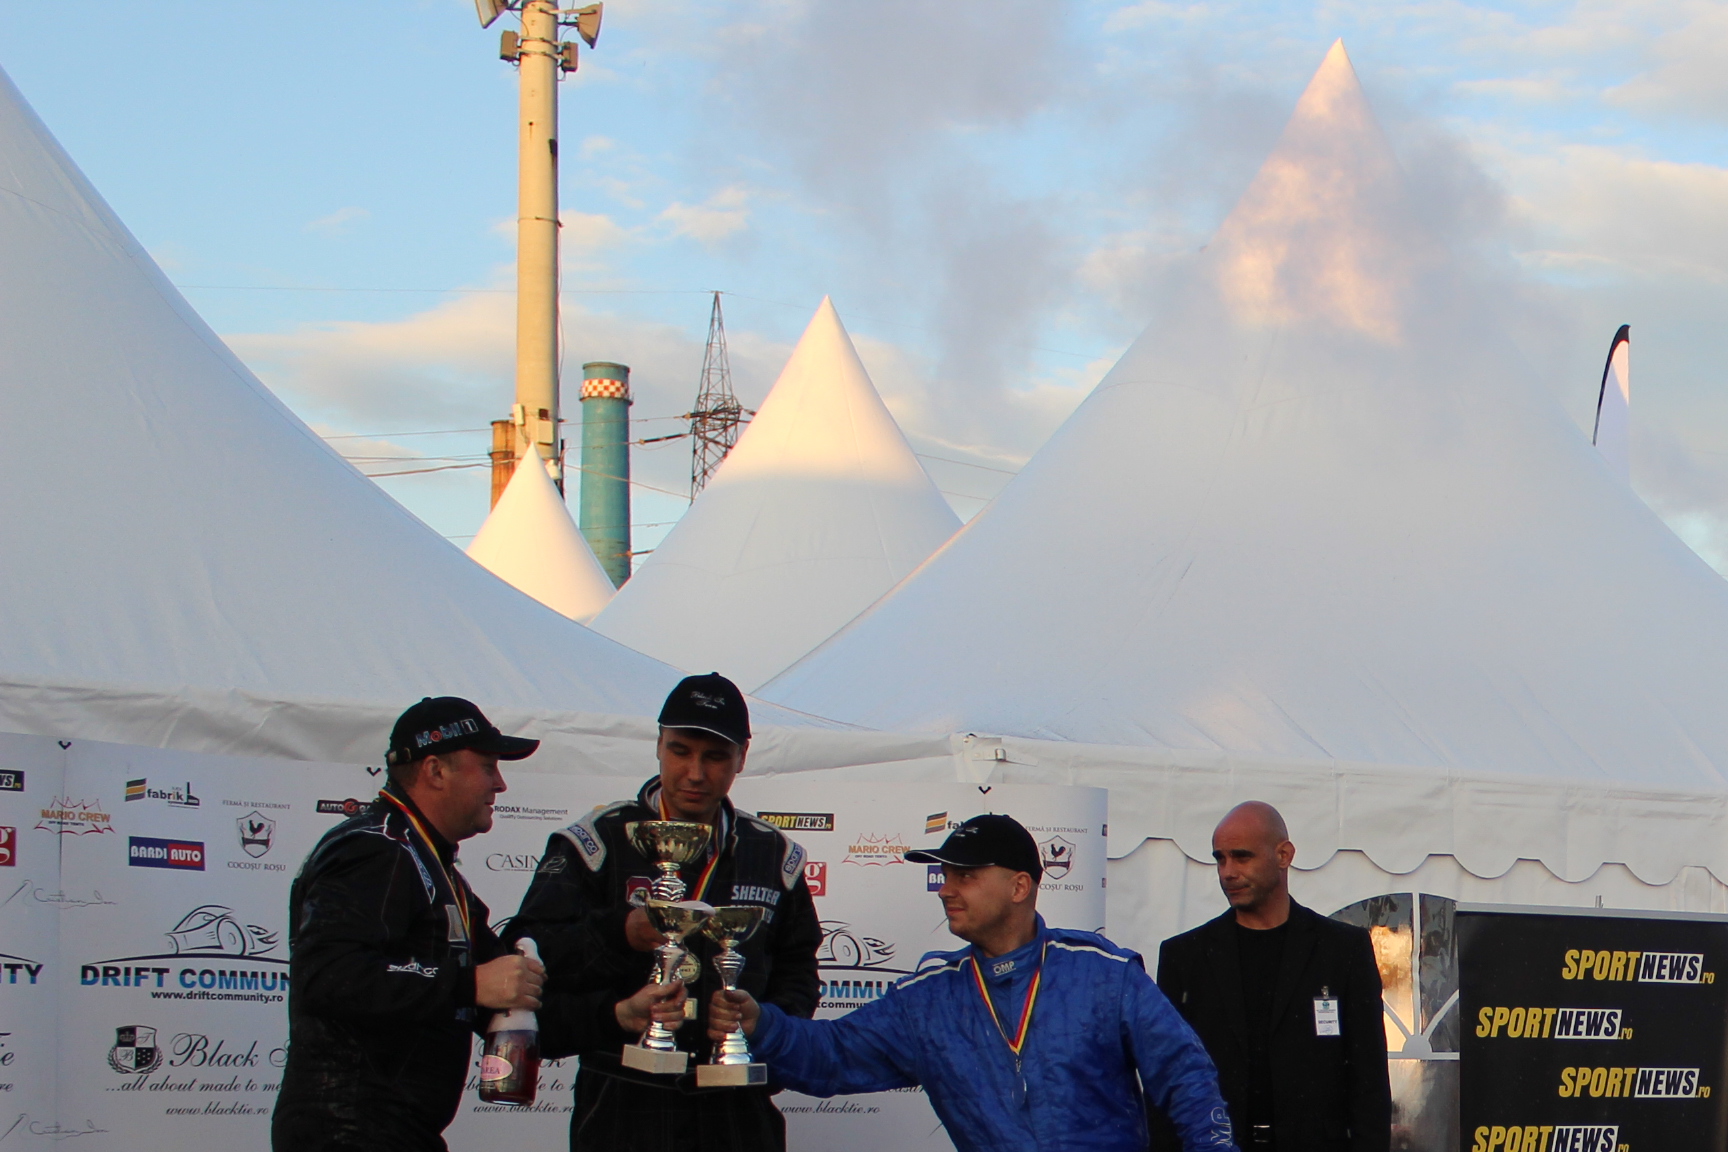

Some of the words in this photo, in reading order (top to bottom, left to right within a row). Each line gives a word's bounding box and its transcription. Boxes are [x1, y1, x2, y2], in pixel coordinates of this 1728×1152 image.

[415, 722, 463, 747] Mobil
[147, 788, 184, 801] fabrik
[320, 803, 343, 811] AUTO
[522, 807, 568, 815] Management
[41, 809, 76, 820] MARIO
[78, 812, 111, 823] CREW
[131, 845, 167, 860] BARDI
[171, 848, 201, 862] AUTO
[849, 845, 879, 853] MARIO
[486, 853, 541, 872] CASIN
[731, 885, 780, 905] SHELTER
[993, 962, 1015, 974] OMP
[1562, 949, 1715, 984] SPORTNEWS.ro
[80, 965, 170, 987] DRIFT
[179, 968, 291, 991] COMMUN
[151, 990, 283, 1003] www.driftcommunity.ro
[1476, 1007, 1633, 1040] SPORTNEWS.ro
[169, 1033, 258, 1068] Black
[149, 1076, 197, 1092] about
[200, 1076, 241, 1092] made
[245, 1077, 258, 1092] to
[1558, 1067, 1711, 1099] SPORTNEWS.ro
[165, 1102, 268, 1115] www.blacktie.ro
[781, 1101, 880, 1113] www.blacktie.ro
